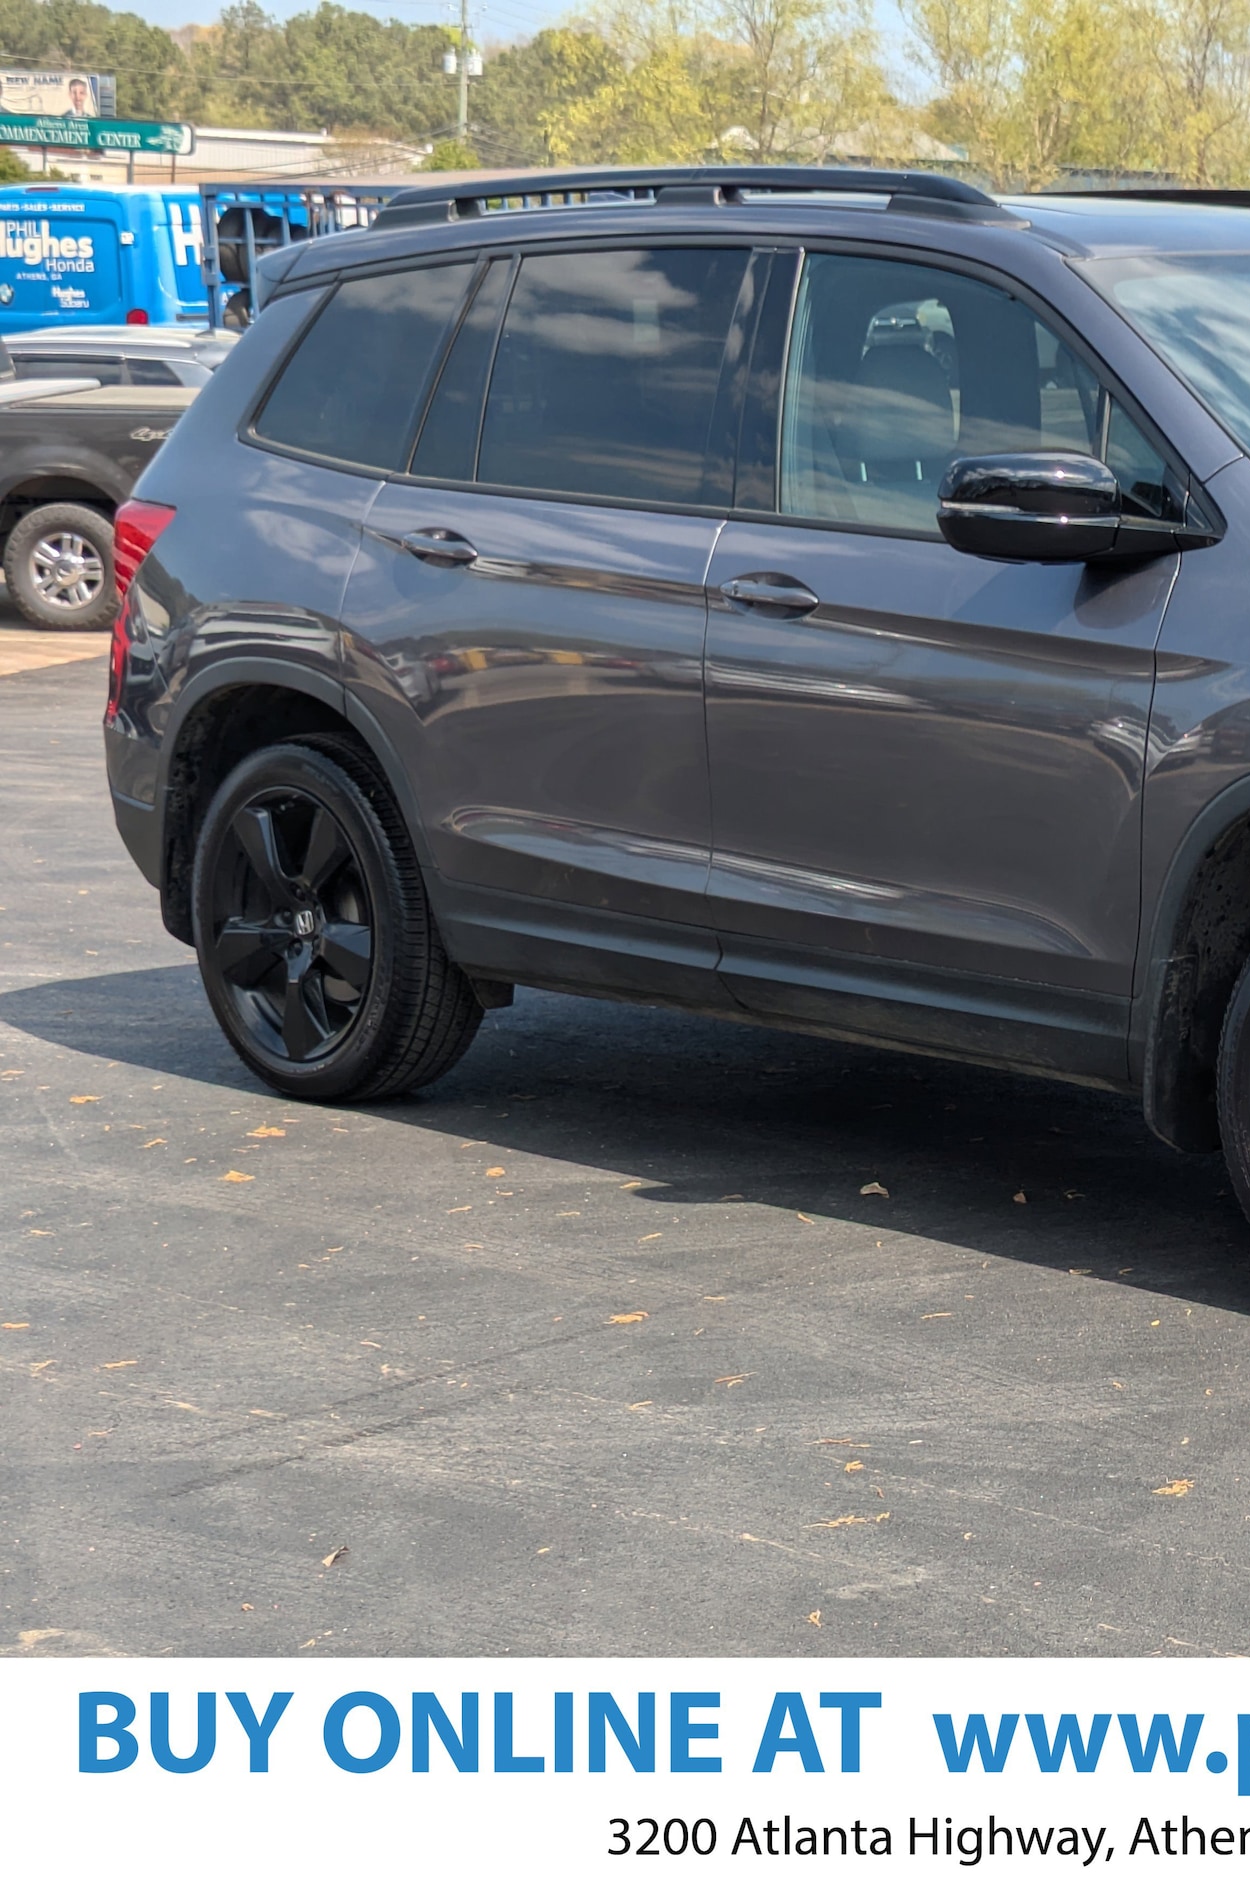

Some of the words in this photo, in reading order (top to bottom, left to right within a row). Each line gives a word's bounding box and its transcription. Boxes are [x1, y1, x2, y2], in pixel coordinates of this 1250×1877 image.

[68, 120, 89, 131] Area
[0, 124, 90, 145] OMMENCEMENT
[97, 131, 142, 148] CENTER
[7, 221, 41, 238] PHIL
[46, 258, 95, 272] Honda
